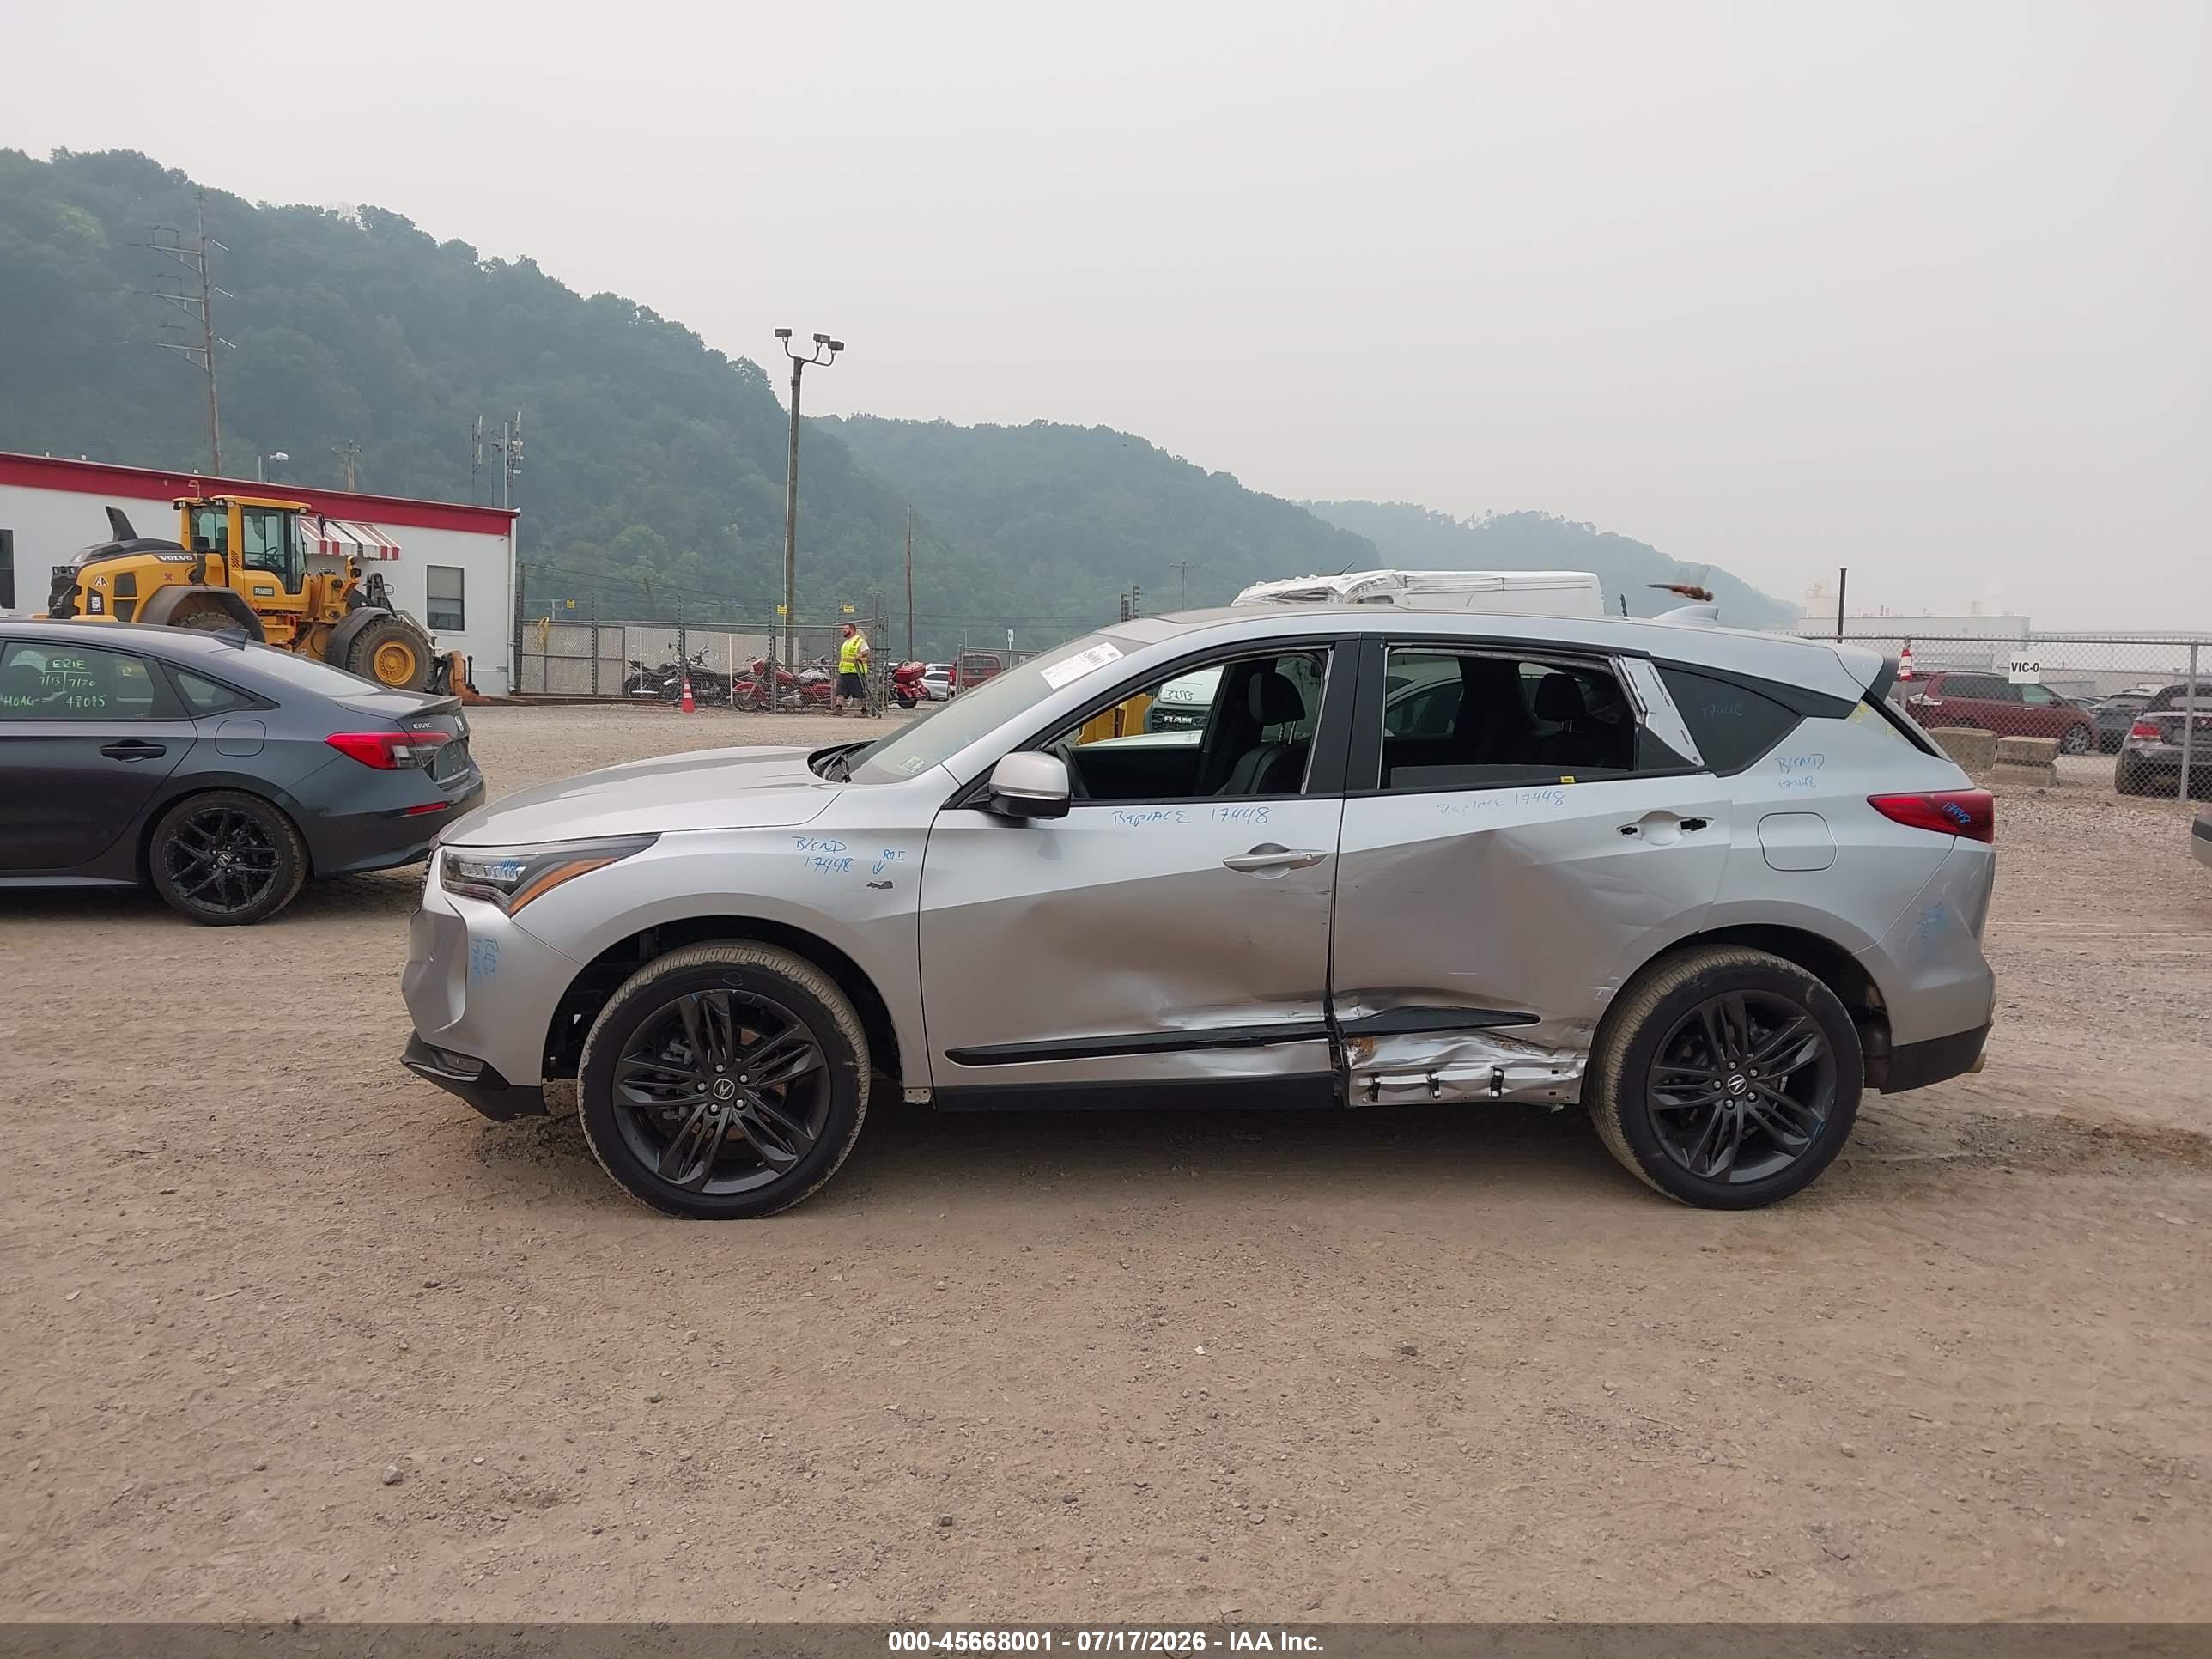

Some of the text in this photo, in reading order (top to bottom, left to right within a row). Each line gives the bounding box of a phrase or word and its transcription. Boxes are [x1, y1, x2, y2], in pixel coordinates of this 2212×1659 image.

[52, 659, 86, 670] ERIE
[2011, 662, 2039, 673] VIC-0
[1164, 715, 1193, 724] RAM
[1514, 789, 1566, 806] 17448
[1211, 805, 1273, 825] 17448
[805, 856, 854, 875] 17448
